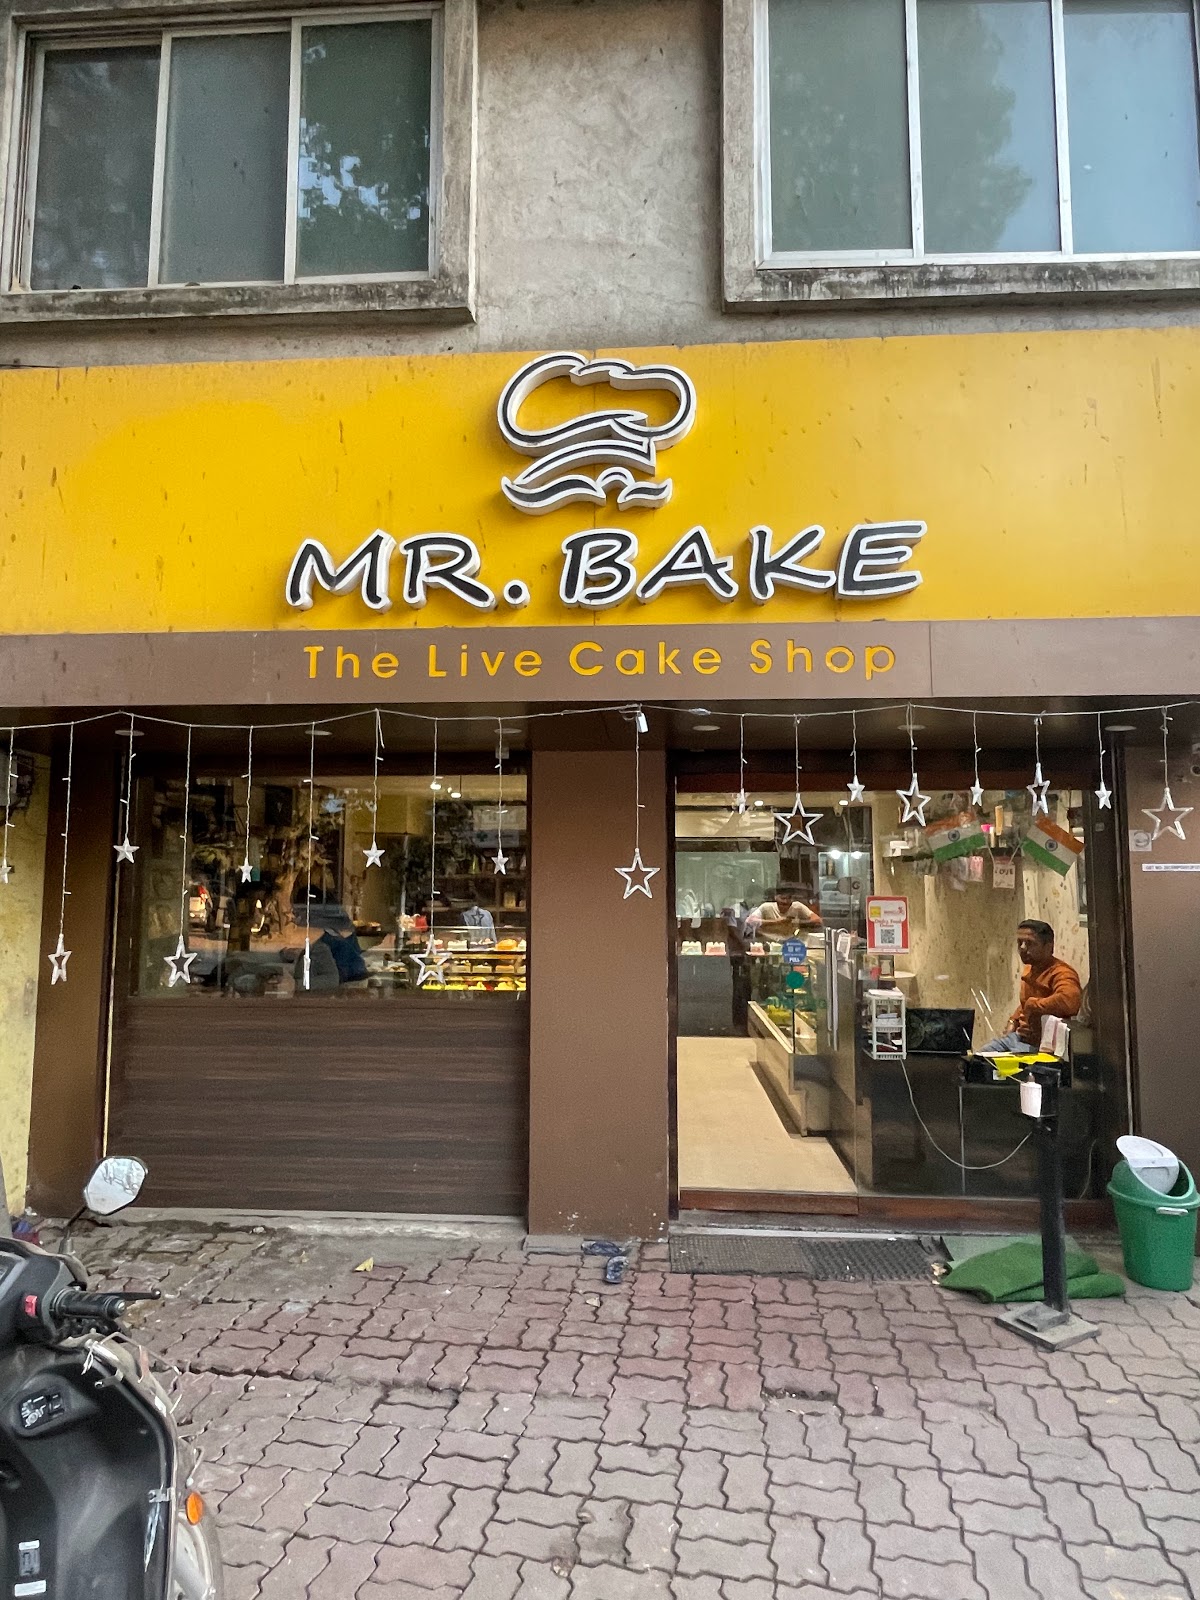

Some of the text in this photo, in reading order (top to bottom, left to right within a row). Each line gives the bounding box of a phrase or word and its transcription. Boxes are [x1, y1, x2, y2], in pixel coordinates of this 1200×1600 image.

[286, 520, 928, 612] MR. BAKE
[303, 639, 897, 680] The Live Cake Shop
